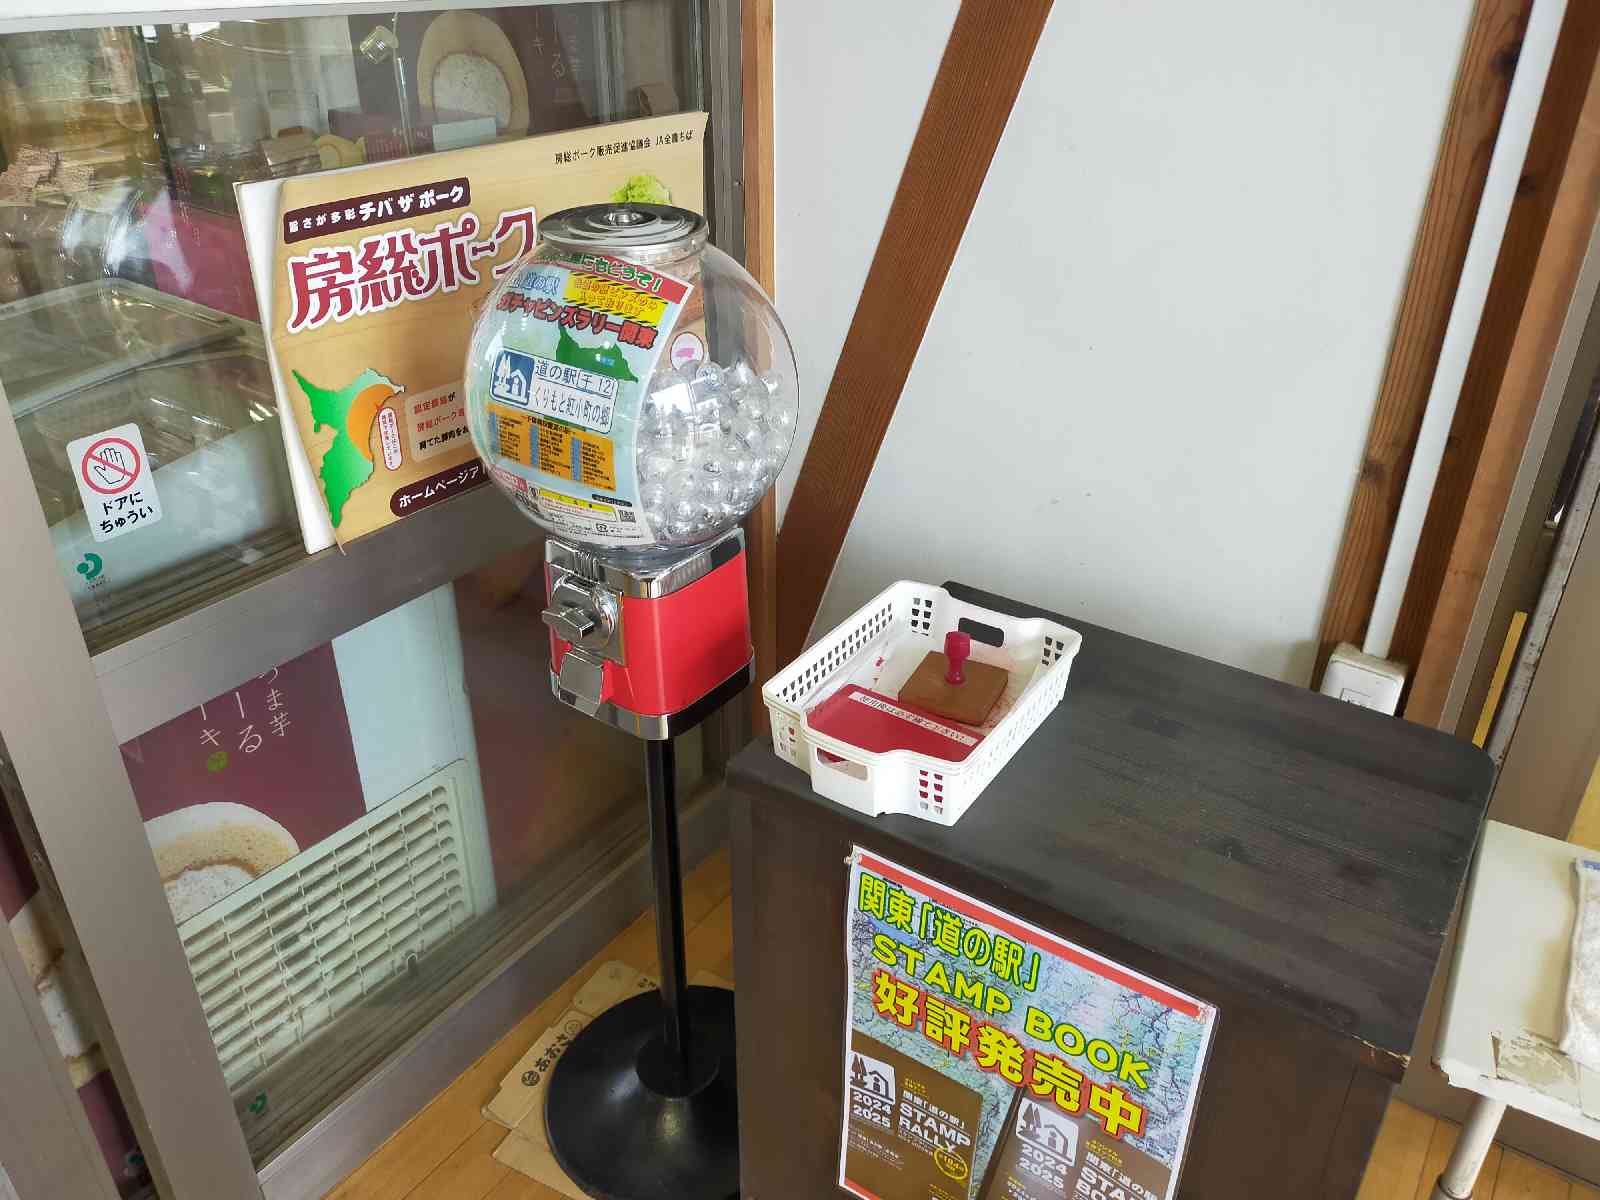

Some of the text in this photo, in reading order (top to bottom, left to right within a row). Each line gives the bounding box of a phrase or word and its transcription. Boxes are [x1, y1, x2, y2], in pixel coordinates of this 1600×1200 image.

[289, 209, 535, 331] 房総ポーク
[100, 505, 154, 534] ちゅうい
[102, 491, 144, 516] ドアに
[857, 871, 1042, 993] 関東「道の駅」
[871, 934, 1152, 1090] STAMP BOOK
[873, 970, 1145, 1136] 好評発売中
[852, 1091, 892, 1115] 2024
[852, 1104, 891, 1128] 2025
[898, 1116, 957, 1153] RALLY
[899, 1102, 971, 1147] STAMP
[1018, 1156, 1065, 1190] 2025
[1021, 1143, 1069, 1176] 2024
